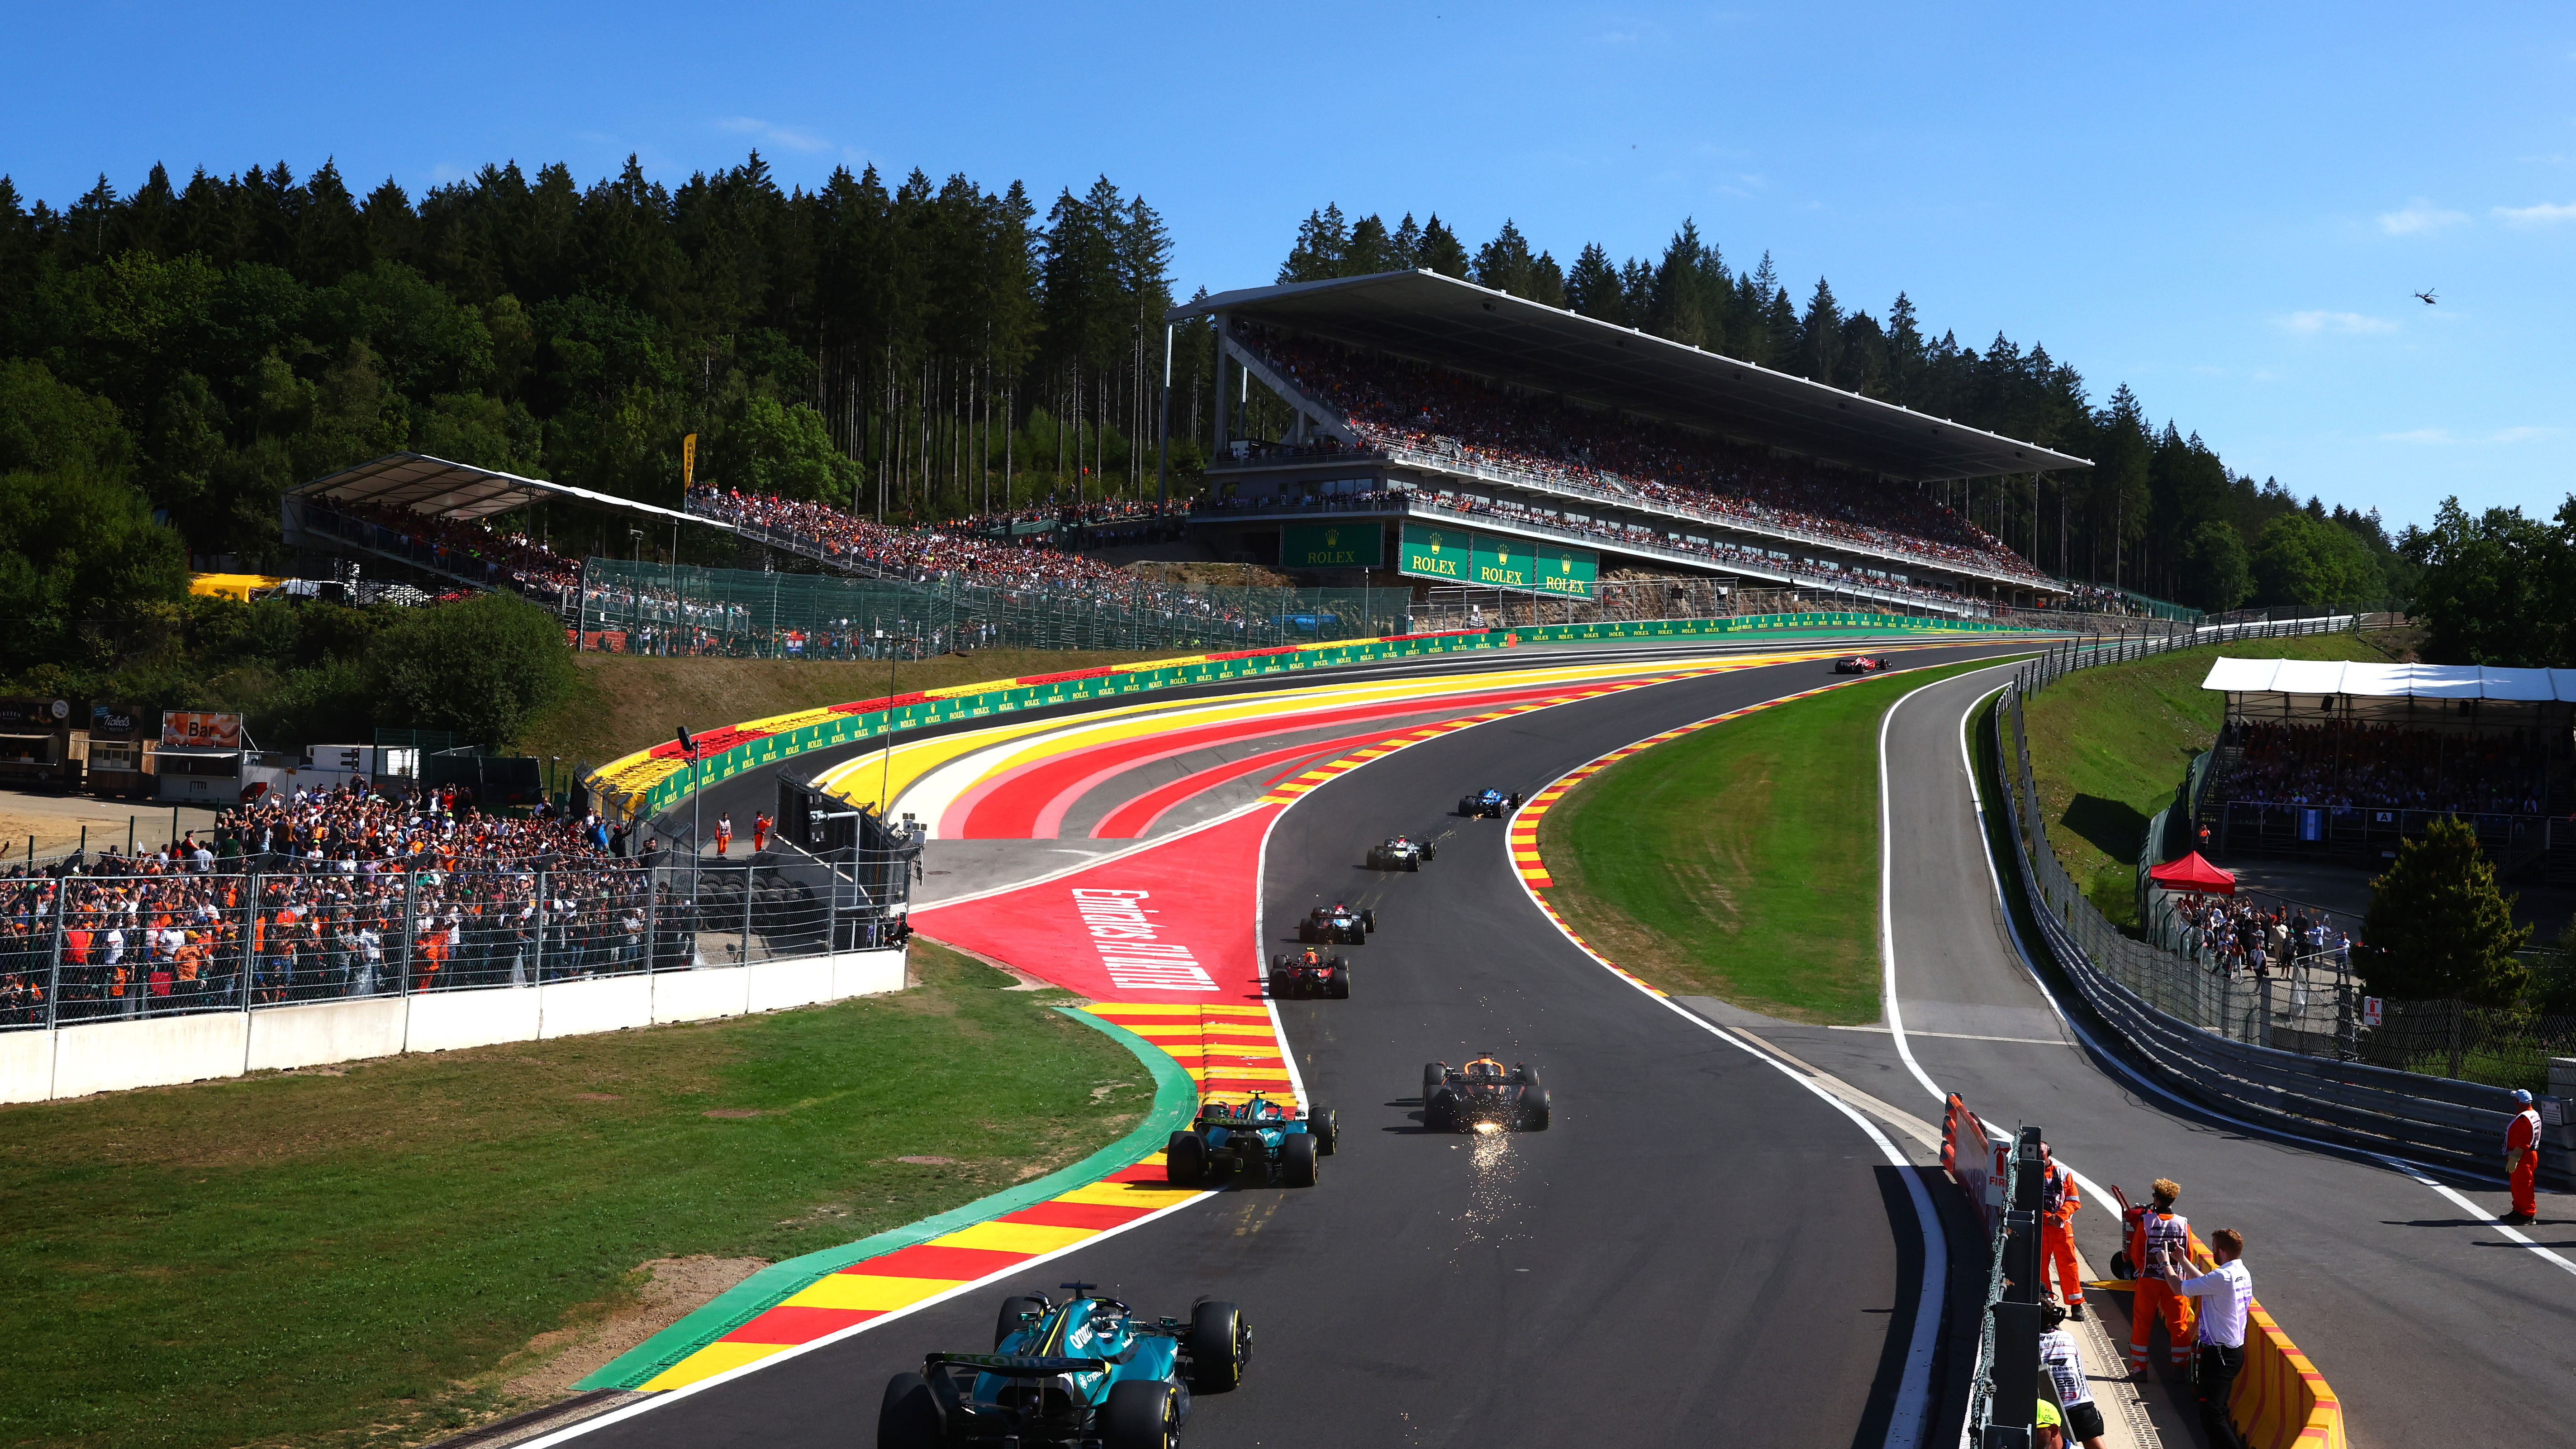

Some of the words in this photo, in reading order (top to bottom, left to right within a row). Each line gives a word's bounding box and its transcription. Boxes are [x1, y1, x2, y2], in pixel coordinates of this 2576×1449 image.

[1308, 552, 1355, 563] ROLEX
[1412, 555, 1456, 576] ROLEX
[1481, 567, 1523, 585] ROLEX
[1546, 576, 1585, 594] ROLEX
[973, 707, 989, 715] ROLEX
[999, 702, 1014, 711] ROLEX
[925, 715, 941, 724] ROLEX
[950, 710, 965, 719] ROLEX
[104, 715, 130, 727] Tickets
[900, 719, 917, 728] ROLEX
[189, 722, 215, 737] Bar
[854, 729, 868, 738] ROLEX
[877, 724, 889, 733] ROLE
[832, 734, 845, 743] ROLEX
[808, 739, 822, 749] ROLEX
[786, 744, 799, 755] ROLEX
[763, 751, 776, 761] ROLEX
[702, 773, 715, 786] ROLEX
[2381, 813, 2388, 821] A
[1071, 888, 1169, 939] Emirates
[1989, 1176, 2007, 1187] FIR
[952, 1354, 1081, 1368] aramco
